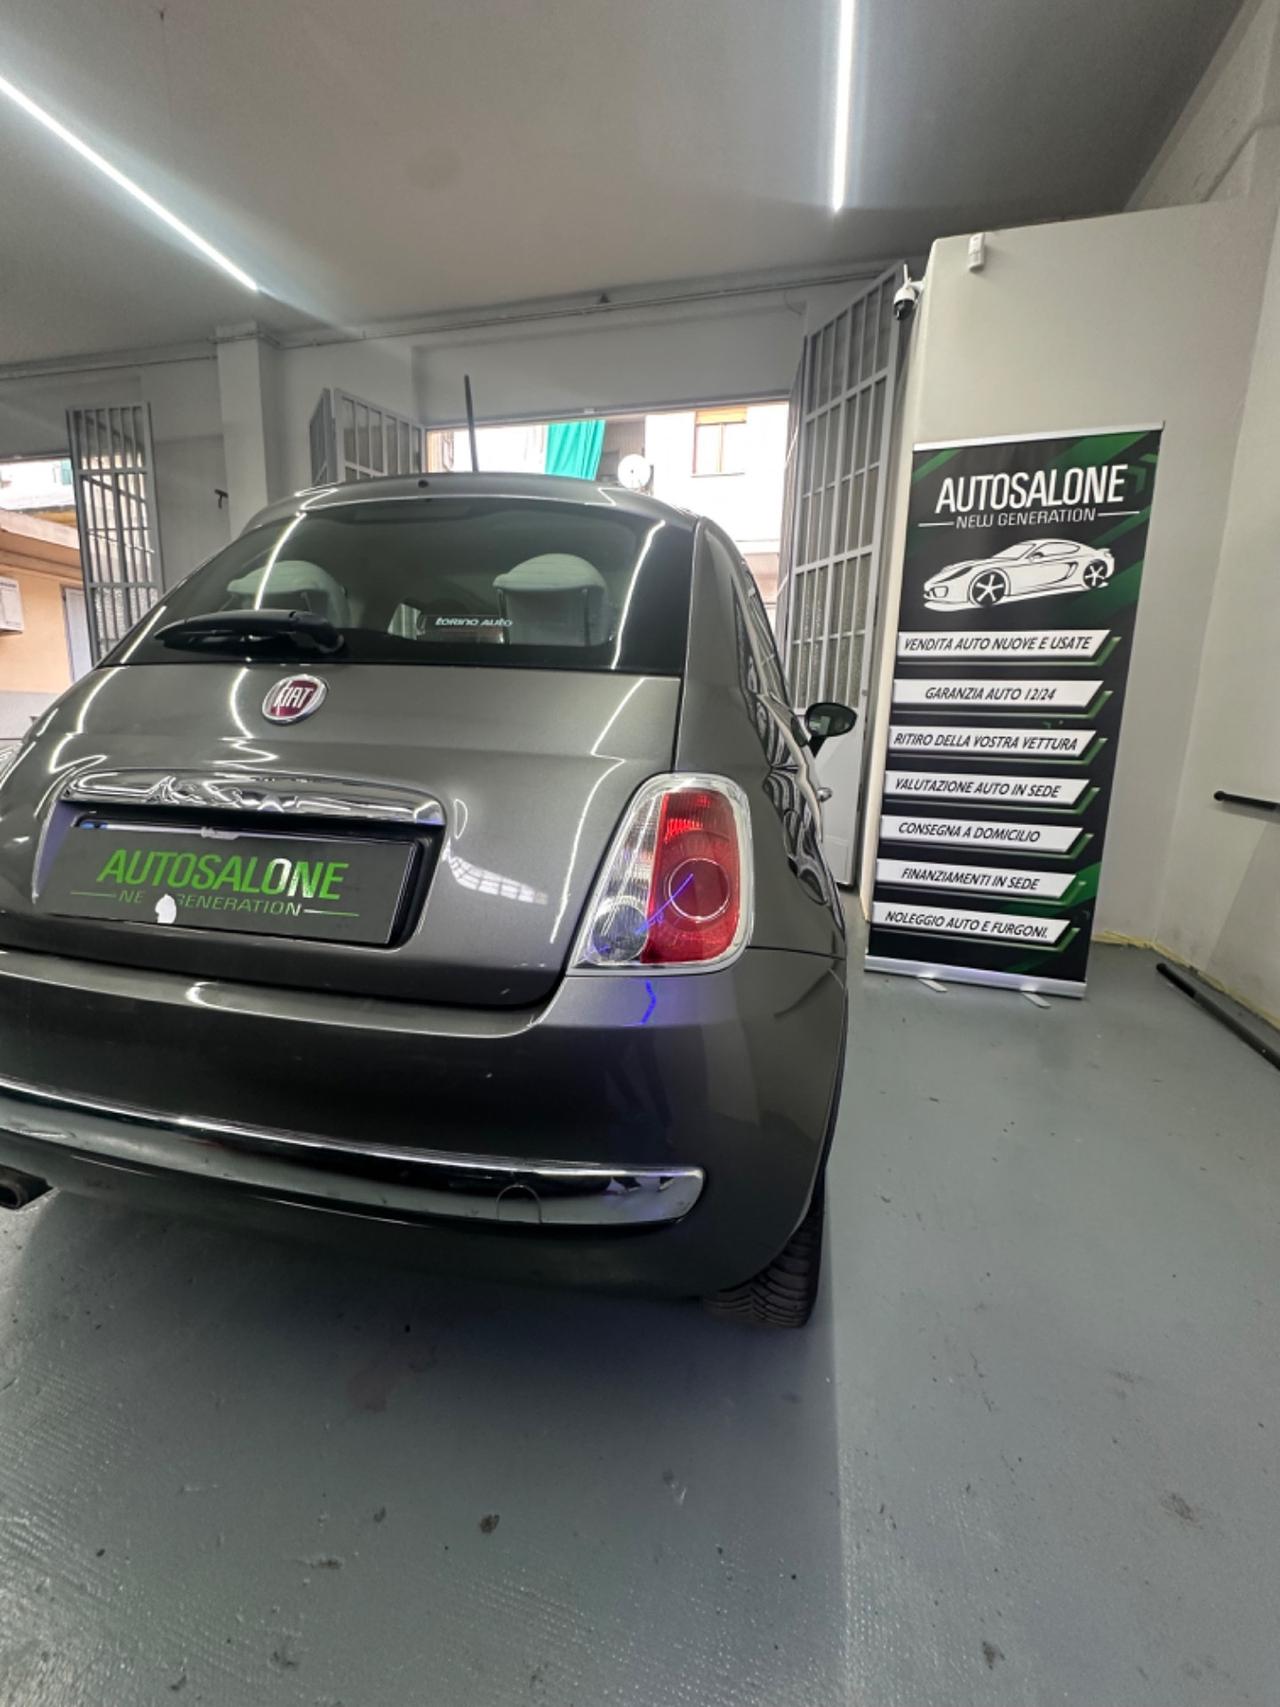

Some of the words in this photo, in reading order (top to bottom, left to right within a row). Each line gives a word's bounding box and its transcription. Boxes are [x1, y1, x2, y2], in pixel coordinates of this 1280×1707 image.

[935, 464, 1128, 514] AUTOSALONE
[998, 507, 1096, 527] GENERATION
[904, 638, 954, 650] VENDITA
[956, 637, 990, 650] AUTO
[991, 637, 1037, 650] NUOVE
[1038, 637, 1048, 649] E
[1050, 636, 1091, 649] USATE
[273, 686, 313, 708] FIAT
[925, 687, 983, 700] GARANZIA
[985, 688, 1022, 700] AUTO
[1023, 688, 1057, 701] 12/24
[893, 733, 932, 746] RITIRO
[934, 735, 970, 747] DELLA
[974, 736, 1018, 748] VOSTRA
[1022, 738, 1077, 750] VETTURA
[895, 778, 973, 793] VALUTAZIONE
[974, 783, 1009, 796] AUTO
[1011, 784, 1026, 796] IN
[1027, 785, 1061, 798] SEDE
[898, 822, 960, 837] CONSEGNA
[961, 827, 971, 838] A
[973, 828, 1040, 842] DOMICILIO
[97, 849, 349, 900] AUTOSALONE
[901, 868, 990, 885] FINANZIAMENTI
[991, 874, 1006, 887] IN
[1007, 876, 1040, 890] SEDE
[885, 911, 945, 927] NOLEGGIO
[945, 918, 979, 932] AUTO
[981, 921, 991, 931] E
[991, 922, 1048, 938] FURGONI.
